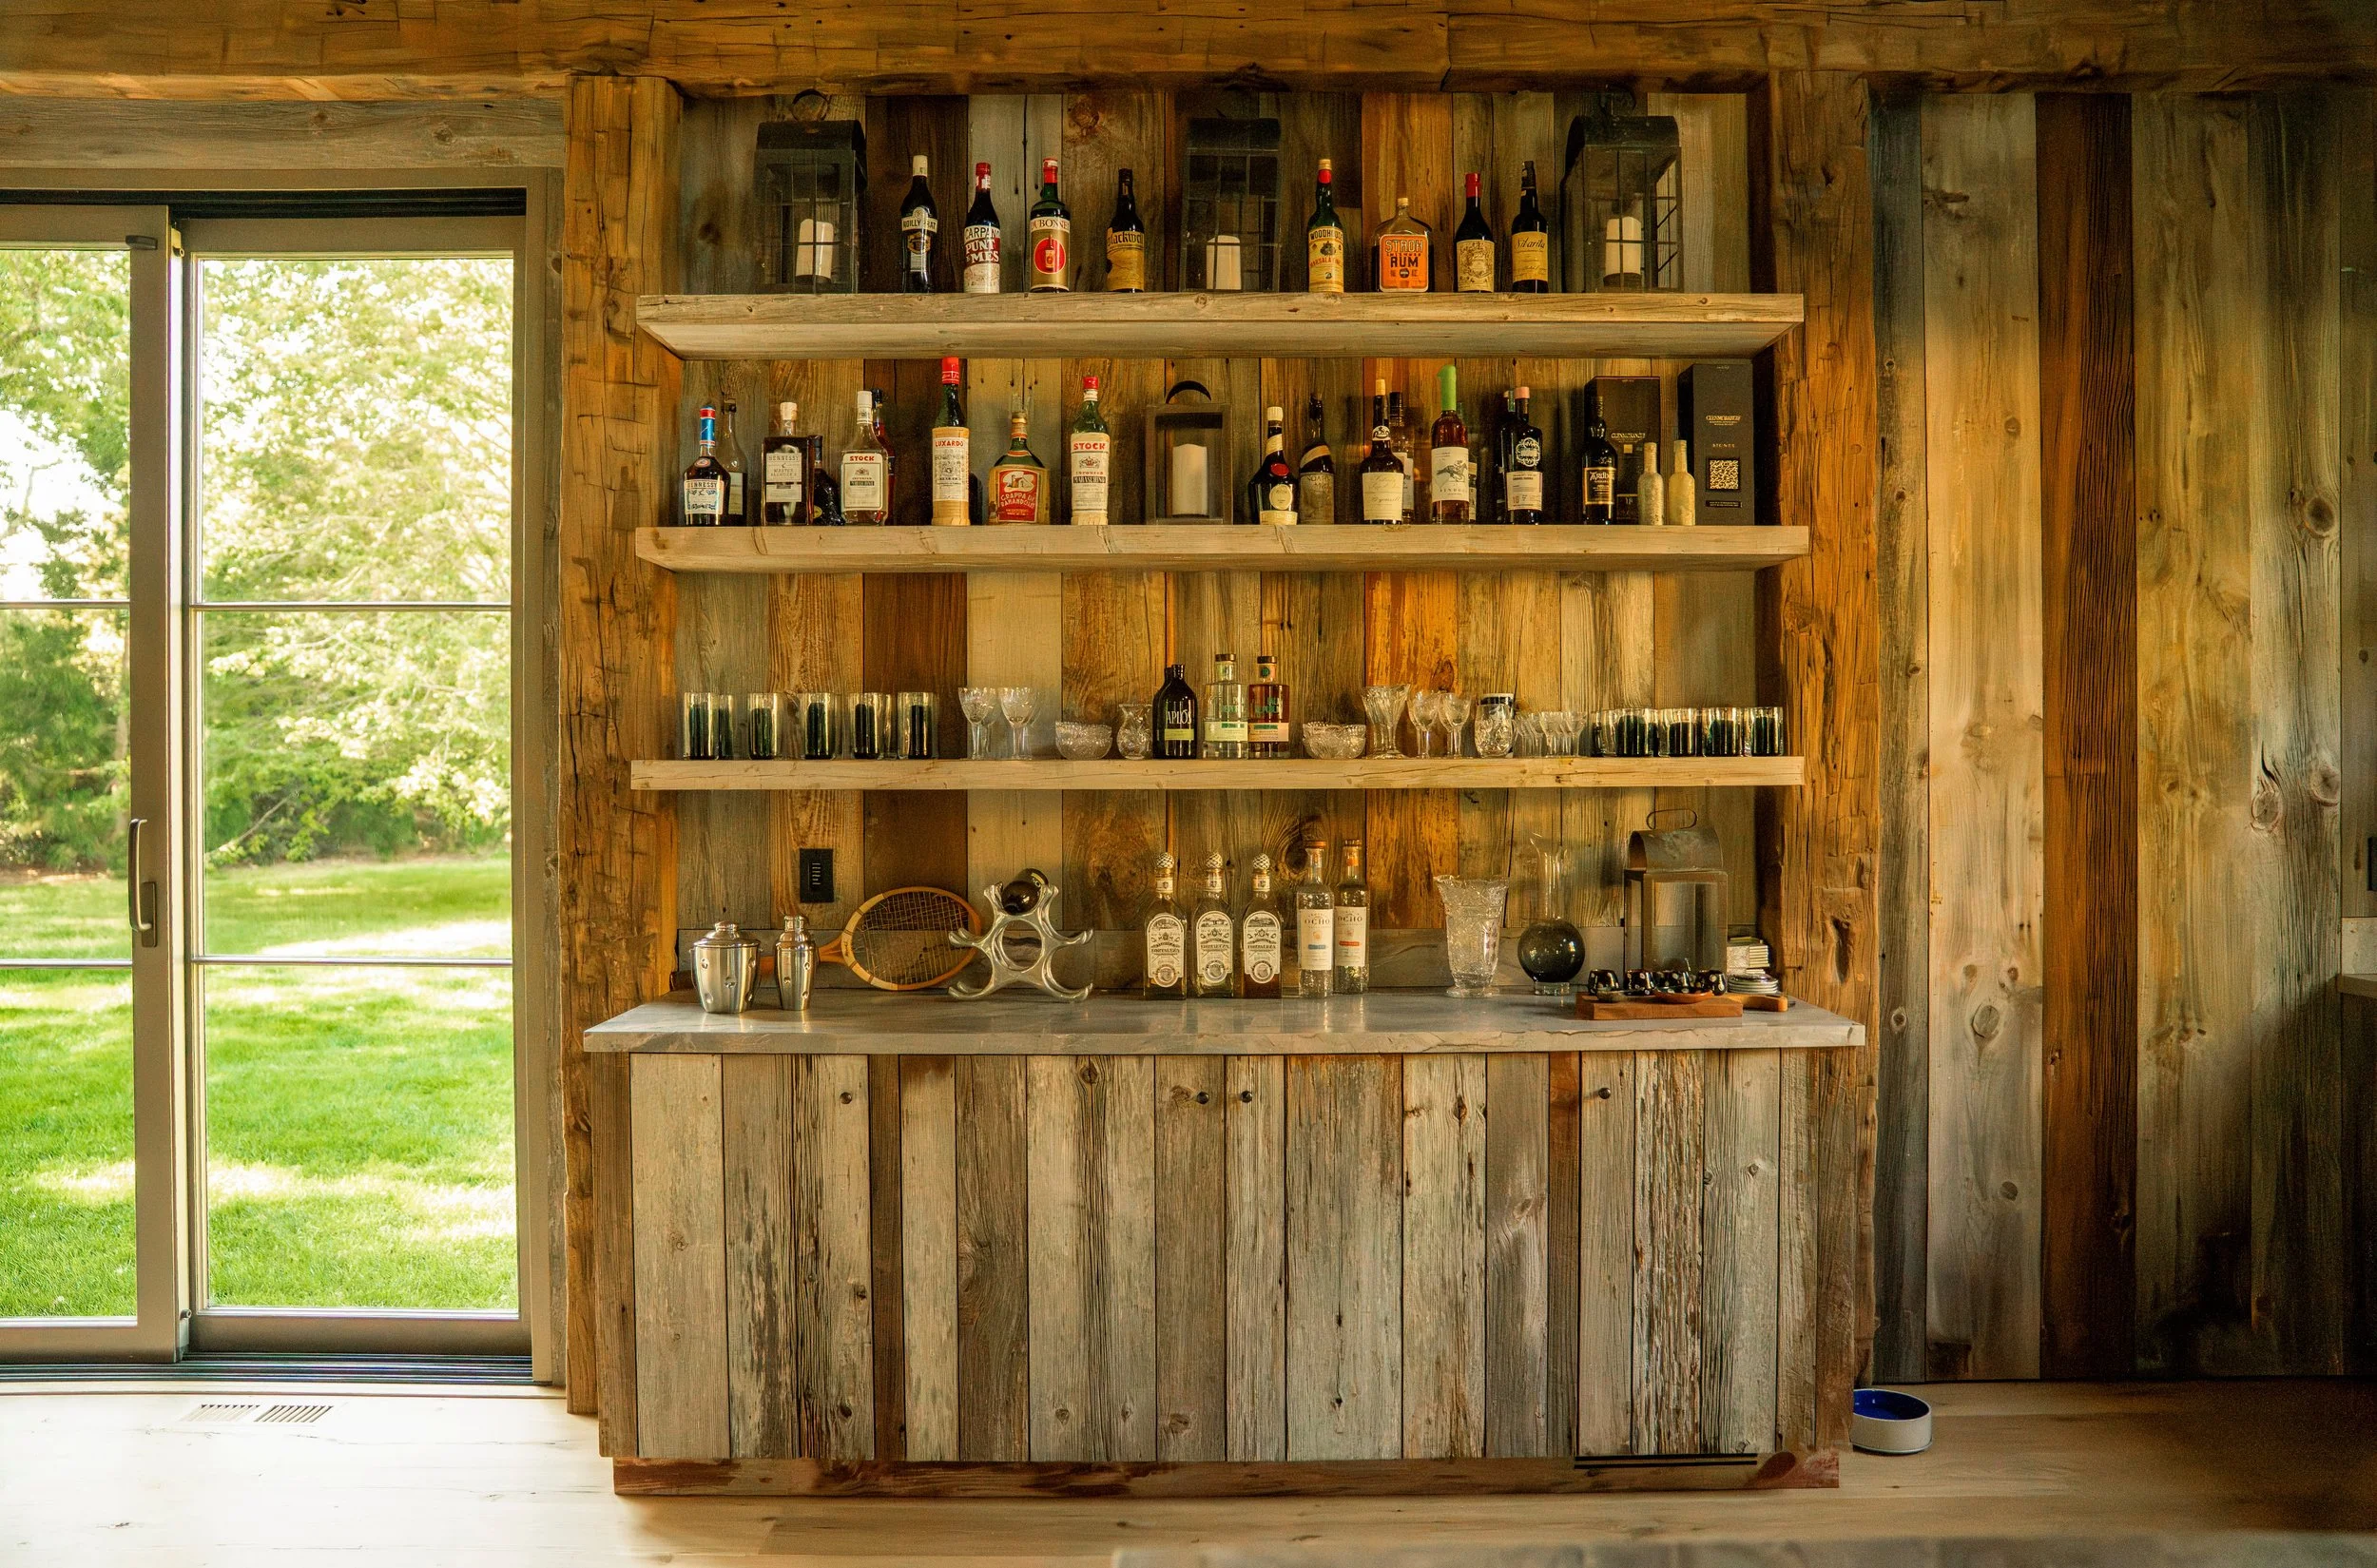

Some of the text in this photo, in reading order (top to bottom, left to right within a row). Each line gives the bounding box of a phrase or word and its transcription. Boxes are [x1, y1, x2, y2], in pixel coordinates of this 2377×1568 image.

[903, 219, 921, 228] NOILLY
[965, 238, 995, 255] PUNT
[1385, 240, 1423, 252] STROH
[972, 250, 999, 263] MES
[1390, 257, 1419, 267] RUM
